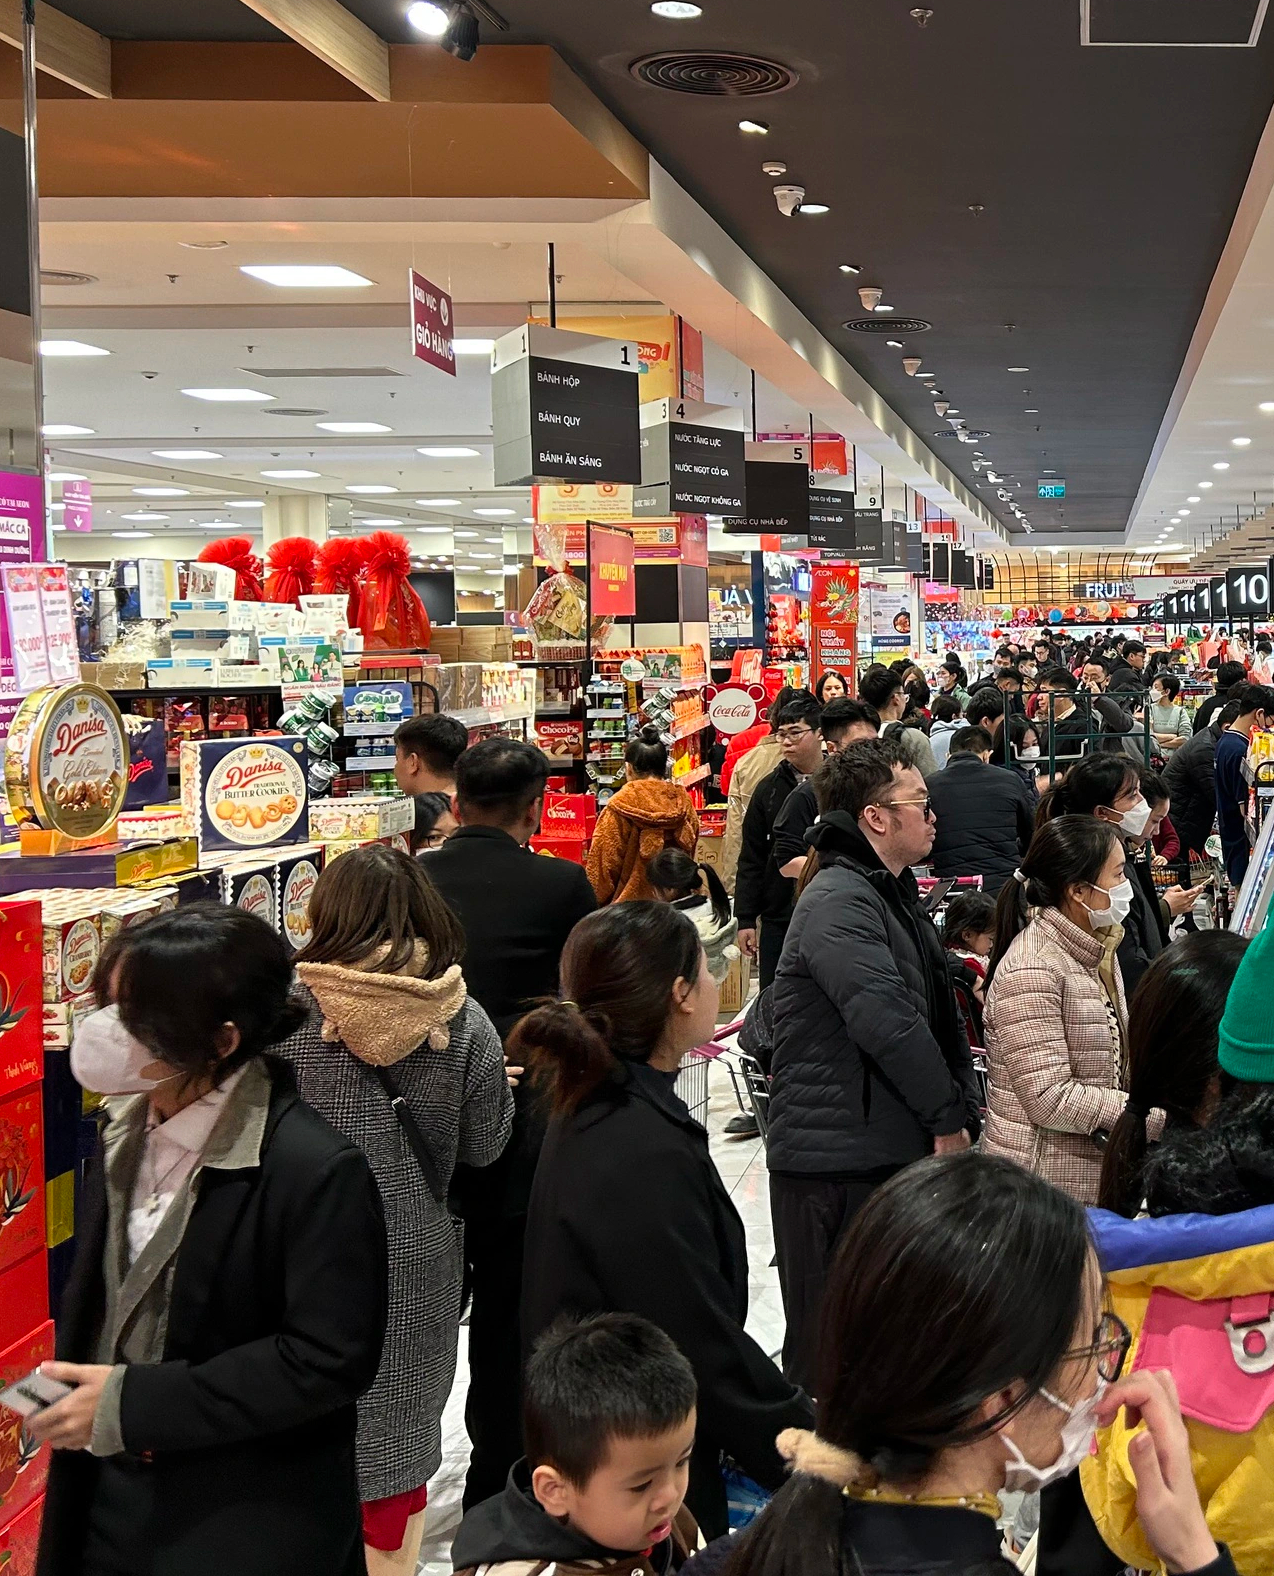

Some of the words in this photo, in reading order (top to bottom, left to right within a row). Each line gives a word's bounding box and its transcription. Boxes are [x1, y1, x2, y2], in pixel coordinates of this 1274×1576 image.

[416, 321, 431, 349] GIỎ
[432, 330, 453, 362] HÀNG
[620, 346, 631, 366] 1
[537, 370, 560, 385] BÁNH
[563, 374, 580, 388] HỘP
[662, 403, 667, 419] 3
[676, 403, 685, 419] 4
[538, 410, 561, 424] BÁNH
[563, 415, 581, 428] QUY
[675, 433, 692, 443] NƯỚC
[540, 451, 562, 464] BÁNH
[565, 452, 577, 465] ĂN
[579, 455, 602, 468] SÁNG
[794, 448, 803, 460] 5
[675, 463, 692, 473] NƯỚC
[694, 467, 710, 475] NGỌT
[711, 466, 720, 475] CÓ
[720, 468, 729, 477] GA
[809, 475, 815, 486] 8
[676, 493, 693, 502] NƯỚC
[694, 496, 710, 505] NGỌT
[733, 499, 741, 507] GA
[869, 497, 876, 506] 9
[728, 518, 748, 526] DỤNG
[749, 518, 759, 526] CỤ
[908, 523, 918, 531] 13
[1233, 574, 1269, 604] 10
[821, 648, 852, 657] KHANG
[712, 704, 752, 718] Coca-Cola
[52, 713, 108, 758] Danisa
[129, 756, 154, 783] Danisa
[221, 758, 286, 791] Danisa
[224, 788, 255, 799] BUTTER
[256, 787, 290, 797] COOKIES
